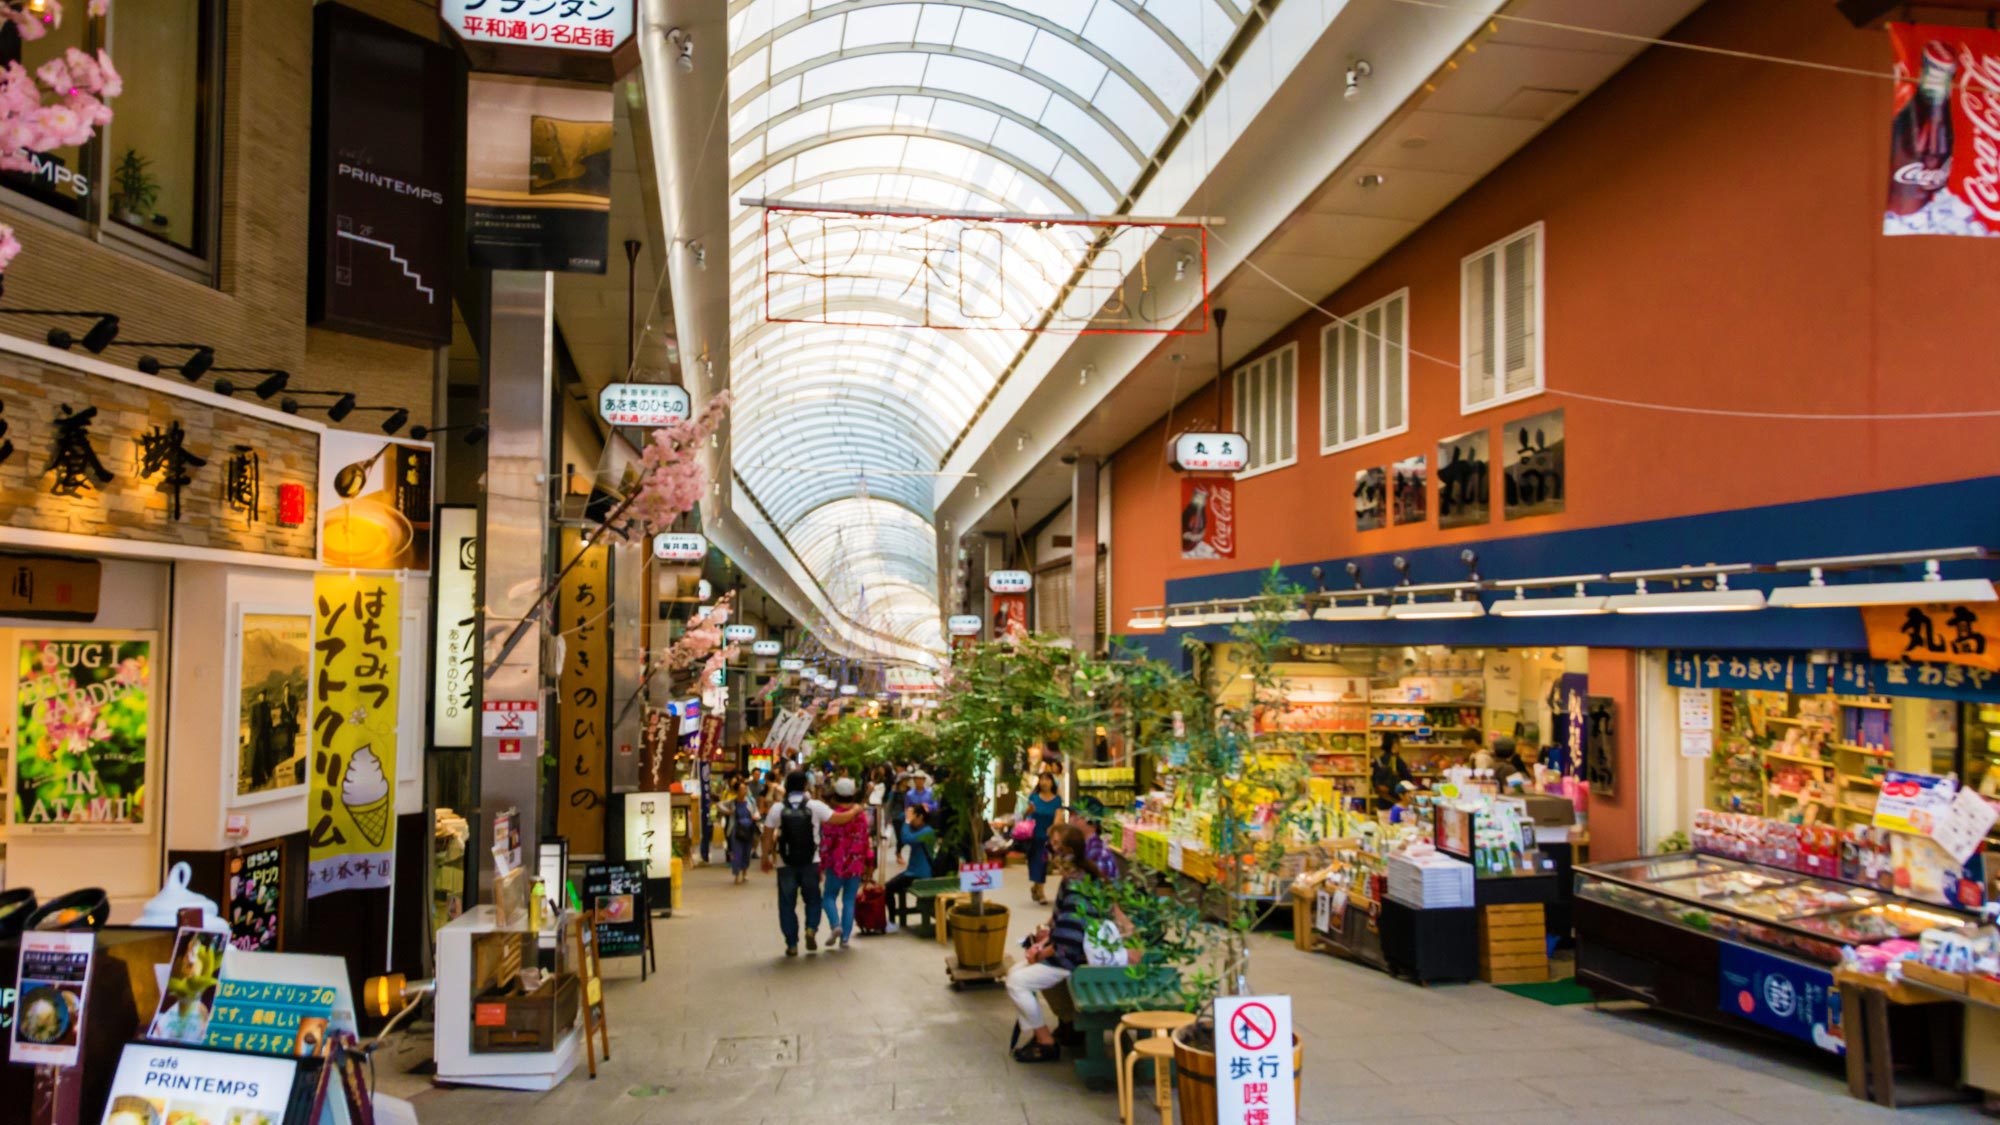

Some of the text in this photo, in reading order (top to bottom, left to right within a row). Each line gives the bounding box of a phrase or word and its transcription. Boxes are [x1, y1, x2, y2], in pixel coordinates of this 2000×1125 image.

[463, 15, 615, 48] 平和通り名店街
[19, 146, 89, 196] MPS
[338, 163, 444, 205] PRINTEMPS
[604, 398, 684, 413] あをきのひもの
[0, 400, 259, 522] 養蜂園
[1210, 482, 1233, 553] Coca-Cola
[43, 643, 121, 669] SUGI
[353, 586, 390, 709] はちみつ
[446, 629, 460, 719] あをきのひもの
[571, 583, 603, 811] あをきのひもの
[309, 594, 347, 848] ソフトクリーム
[65, 771, 98, 795] IN
[28, 798, 127, 822] ATAMI
[150, 1056, 179, 1070] café
[1230, 1054, 1280, 1080] 歩行
[145, 1071, 260, 1098] PRINTEMPS
[1243, 1082, 1270, 1125] 喫煙
